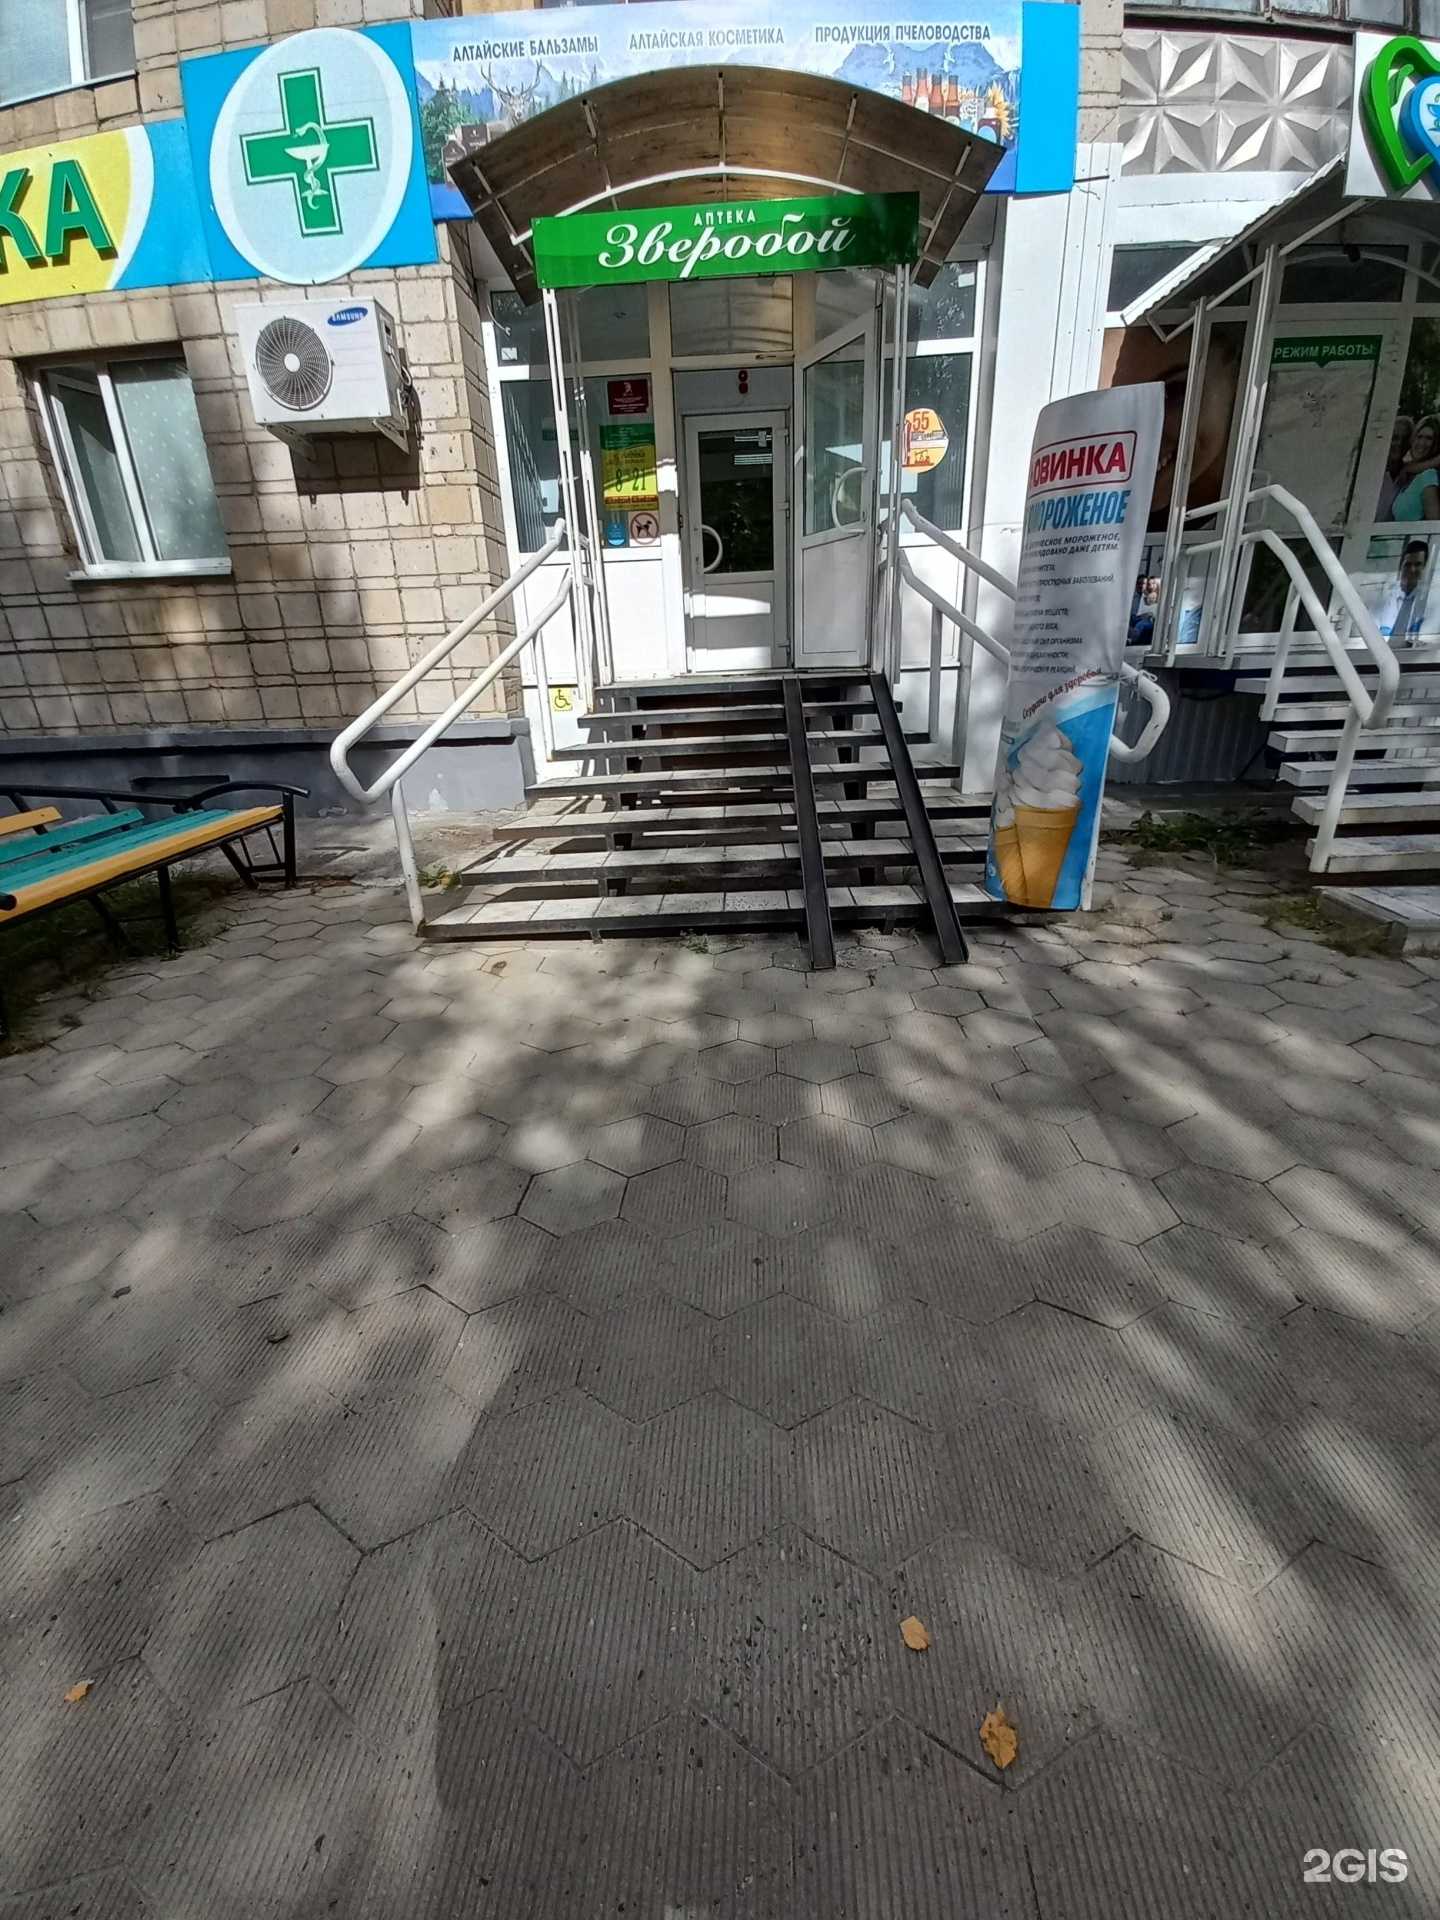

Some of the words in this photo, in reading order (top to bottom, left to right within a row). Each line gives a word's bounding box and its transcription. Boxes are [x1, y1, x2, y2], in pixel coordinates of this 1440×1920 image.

[629, 29, 704, 50] АЛТАЙСКАЯ
[708, 27, 784, 46] КОСМЕТИКА
[815, 24, 890, 44] ПРОДУКЦИЯ
[895, 24, 991, 43] ПЧЕЛОВОДСТВА
[453, 40, 525, 63] АЛТАЙСКИЕ
[530, 35, 598, 57] БАЛЬЗАМЫ
[693, 209, 756, 227] АПТЕКА
[598, 212, 856, 279] Зверобой
[1274, 344, 1319, 358] РЕЖИМ
[1031, 441, 1127, 488] ОВИНКА
[1028, 489, 1132, 533] ОРОЖЕНОЕ
